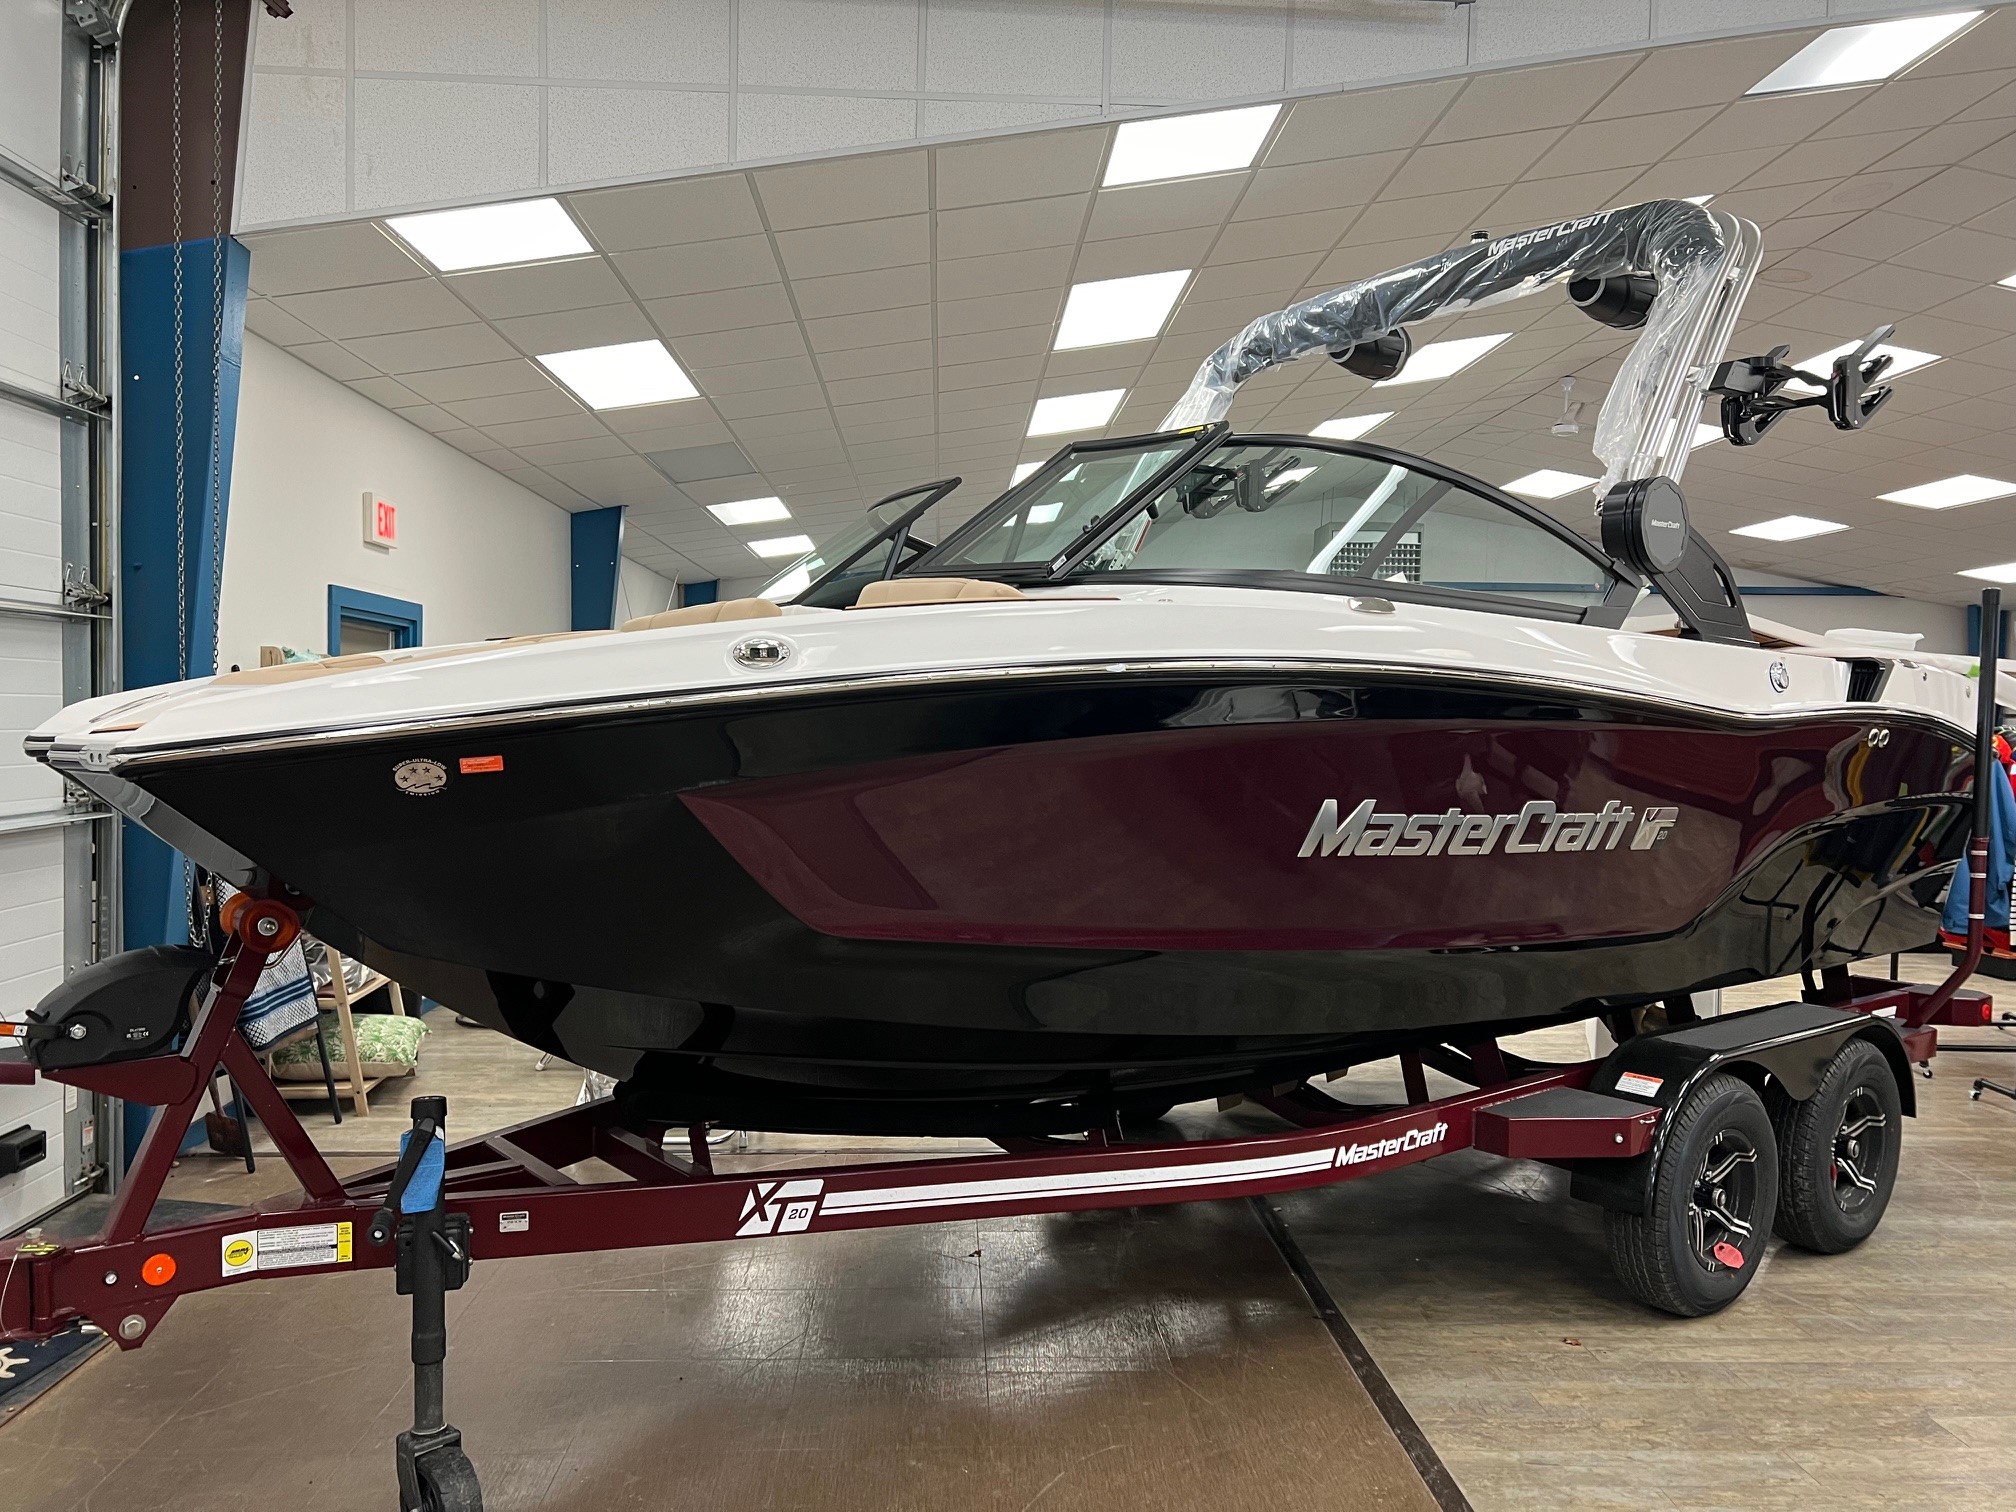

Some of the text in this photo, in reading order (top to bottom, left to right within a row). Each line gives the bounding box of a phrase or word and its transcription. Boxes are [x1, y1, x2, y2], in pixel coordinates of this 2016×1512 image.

[1487, 211, 1615, 257] MasterCraft
[378, 502, 395, 540] EXIT
[1298, 799, 1635, 858] MasterCraft
[1334, 1122, 1449, 1168] MasterCraft
[788, 1208, 809, 1220] 20
